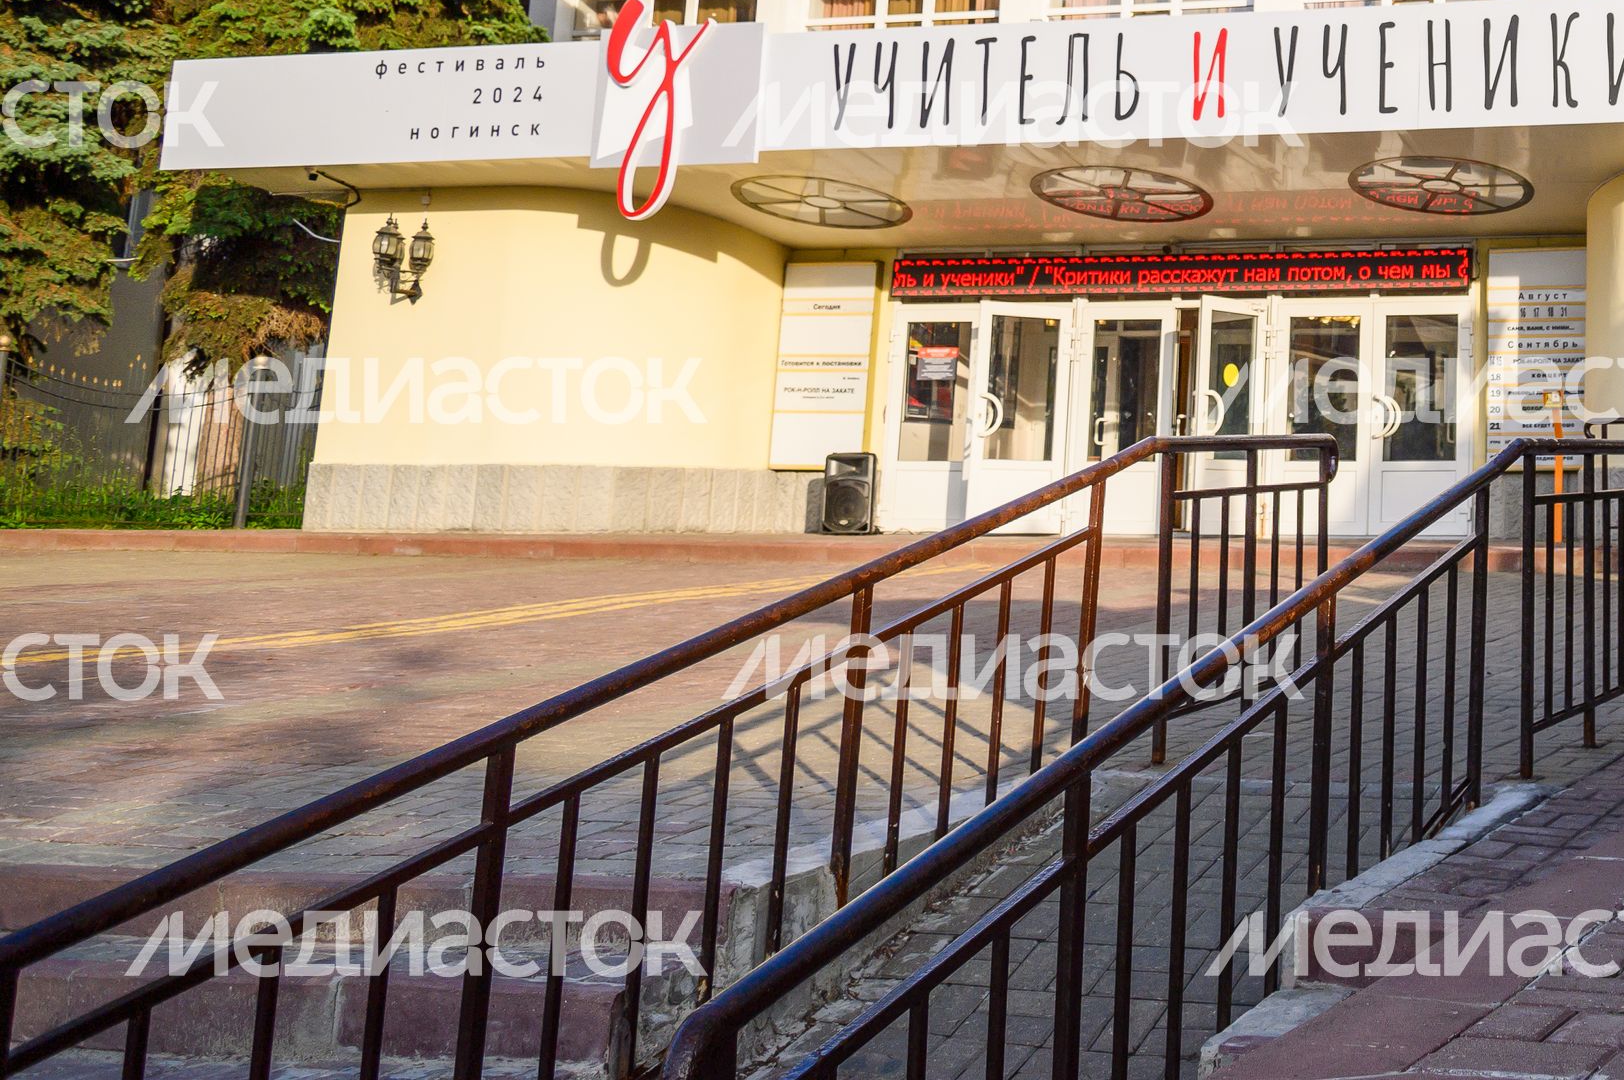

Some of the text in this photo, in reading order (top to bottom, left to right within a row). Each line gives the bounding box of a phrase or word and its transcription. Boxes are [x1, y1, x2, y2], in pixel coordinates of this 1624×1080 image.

[374, 54, 547, 80] фестиваль
[833, 32, 1141, 131] УЧИТЕЛЬ
[1192, 27, 1229, 121] И
[472, 84, 545, 107] 2024
[409, 122, 542, 141] ногинск
[922, 274, 935, 288] и
[1138, 266, 1239, 288] расскажут
[1244, 267, 1281, 283] нам
[1287, 265, 1353, 285] потом,
[1358, 265, 1372, 281] о
[1377, 263, 1414, 280] чем
[1421, 262, 1451, 279] мы
[1518, 292, 1568, 301] Август
[812, 303, 841, 311] Сегодня
[1507, 339, 1578, 349] Сентябрь
[780, 359, 815, 368] Готовится
[1490, 389, 1501, 398] 19
[1489, 406, 1501, 414] 20
[1489, 422, 1501, 430] 21
